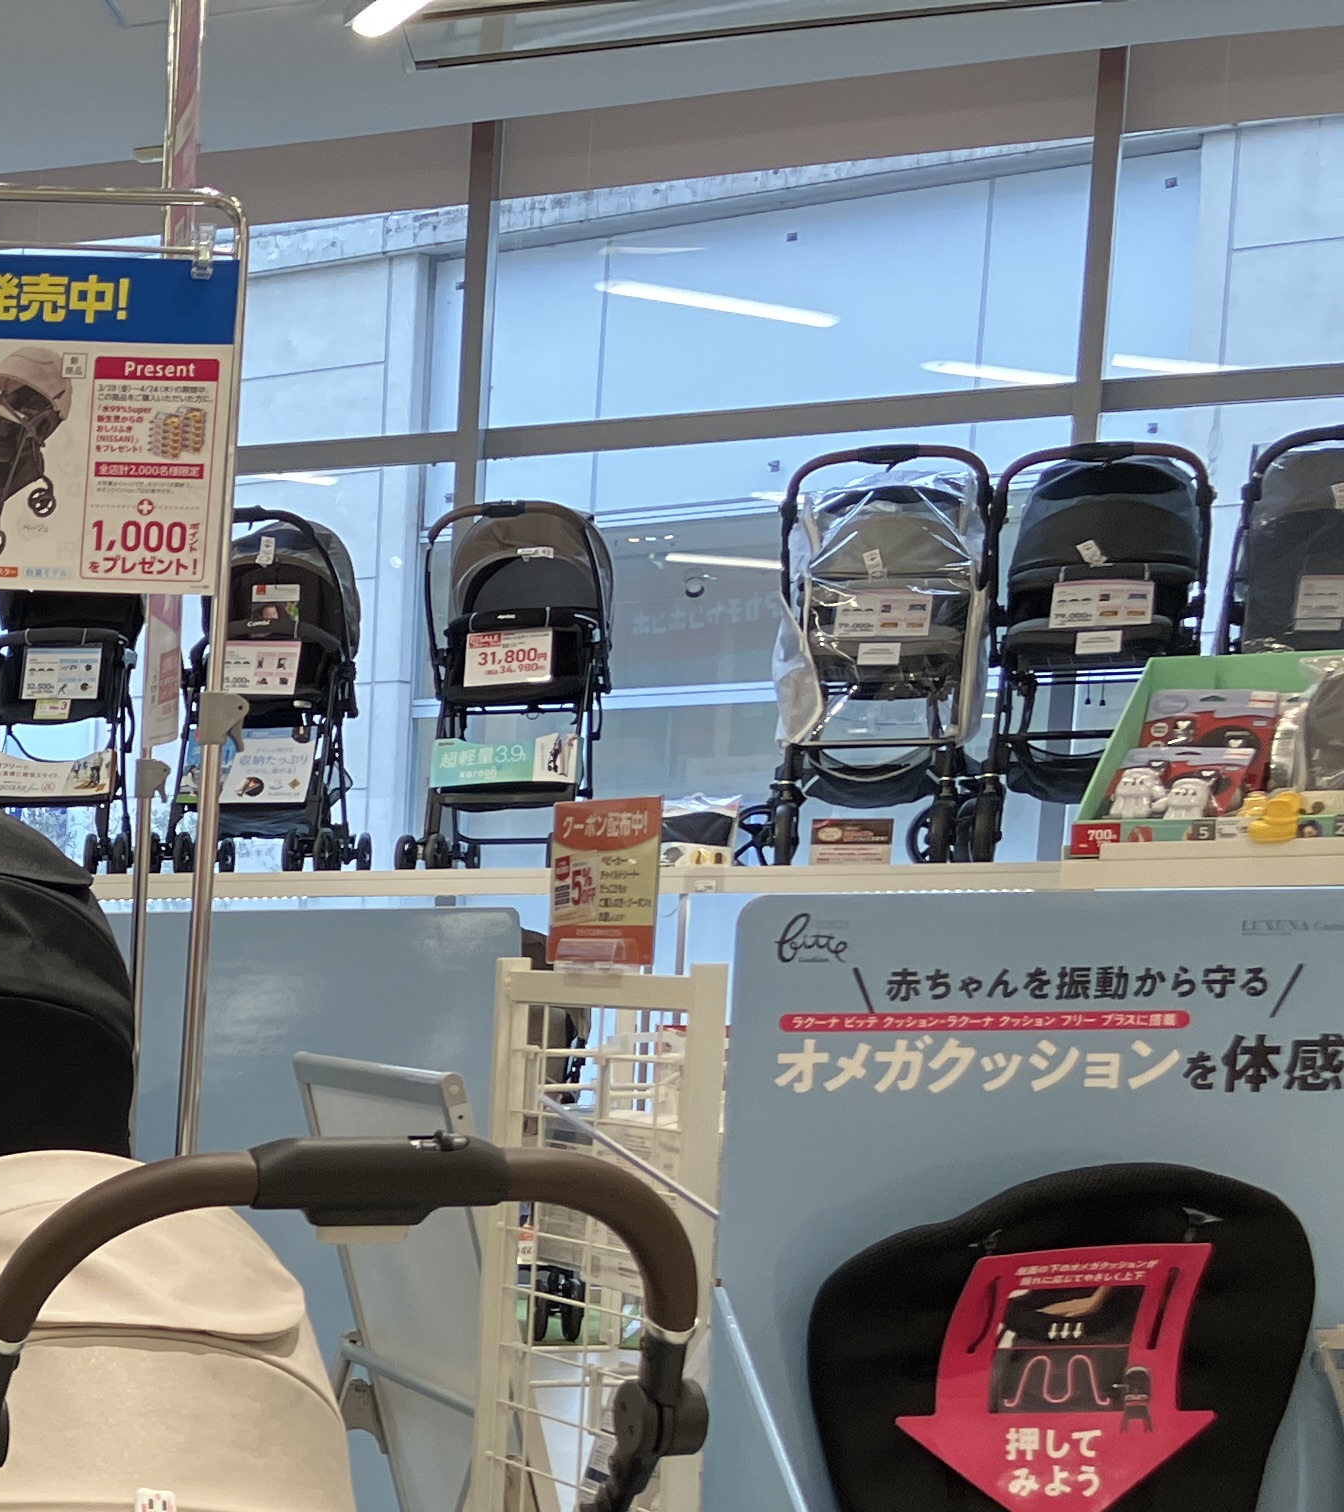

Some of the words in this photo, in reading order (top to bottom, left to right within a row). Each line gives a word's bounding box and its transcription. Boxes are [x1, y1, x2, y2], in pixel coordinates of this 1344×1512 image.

[124, 361, 195, 377] Present
[91, 520, 187, 553] 1,000
[478, 647, 547, 666] 31,800円
[886, 966, 1270, 1002] 赤ちゃんを振動から守る
[791, 1016, 838, 1029] ラクーナ
[999, 1015, 1056, 1027] クッション
[1061, 1015, 1096, 1027] フリー
[774, 1033, 1344, 1096] オメガクッションを体感
[1005, 1427, 1102, 1460] 押して
[1007, 1465, 1101, 1496] みよう
